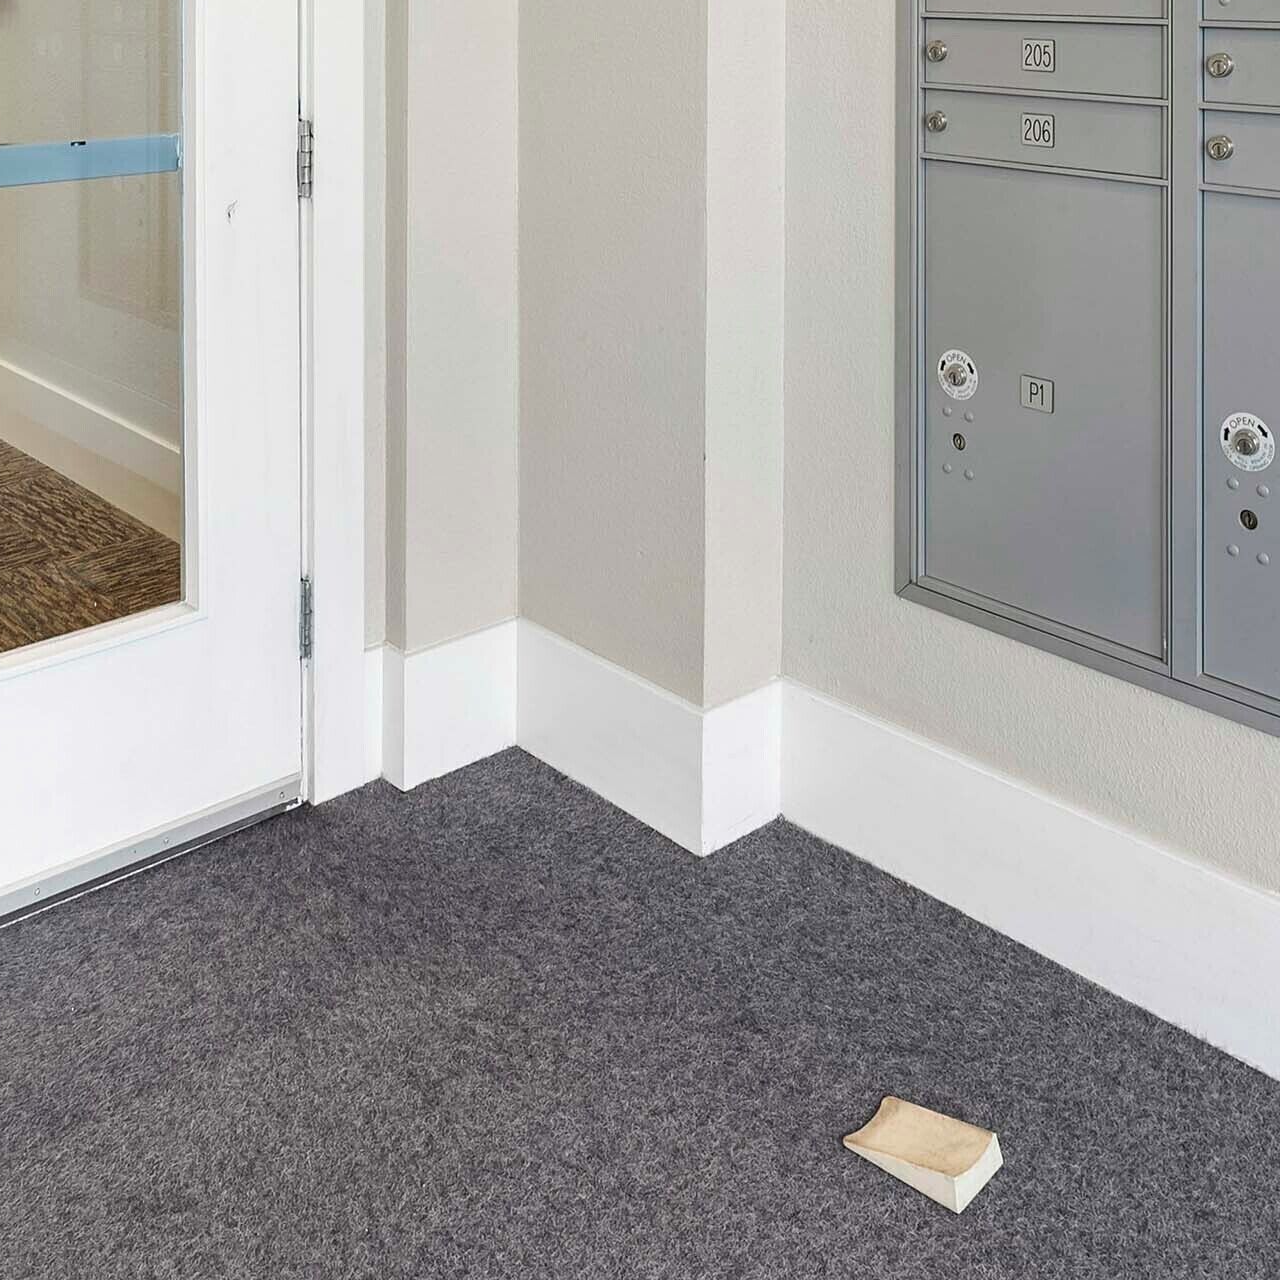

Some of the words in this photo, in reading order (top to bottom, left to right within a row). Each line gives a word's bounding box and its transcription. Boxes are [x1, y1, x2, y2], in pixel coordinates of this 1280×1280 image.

[1024, 43, 1052, 68] 205
[1024, 118, 1051, 143] 206
[1029, 381, 1044, 406] P1
[1229, 416, 1256, 429] OPEN
